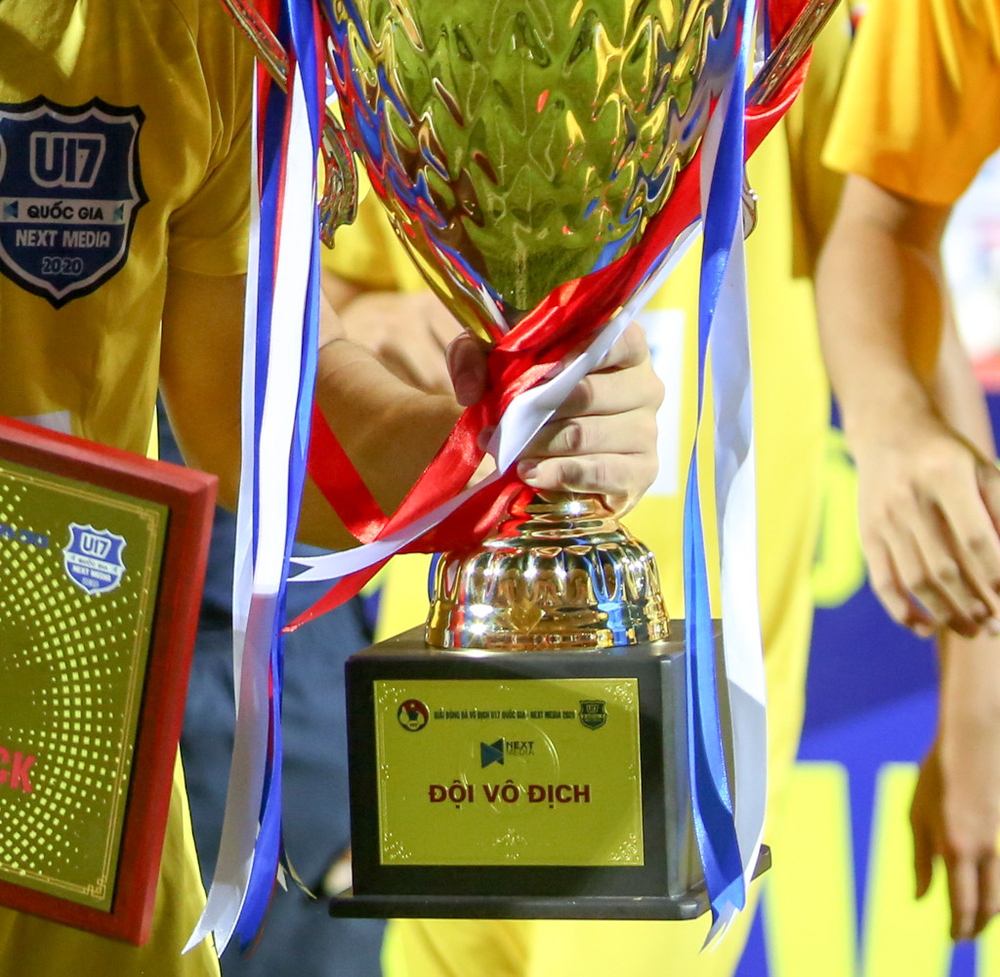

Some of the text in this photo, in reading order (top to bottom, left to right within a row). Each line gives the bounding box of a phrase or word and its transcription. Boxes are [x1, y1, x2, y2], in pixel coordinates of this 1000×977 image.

[30, 131, 106, 188] U17
[27, 201, 104, 221] QUỐC GIA
[16, 229, 112, 249] NEXT MEDIA
[41, 256, 84, 275] 2020
[81, 532, 112, 560] U17
[506, 741, 534, 750] NEXT
[428, 779, 590, 809] ĐỘI VÔ ĐỊCH
